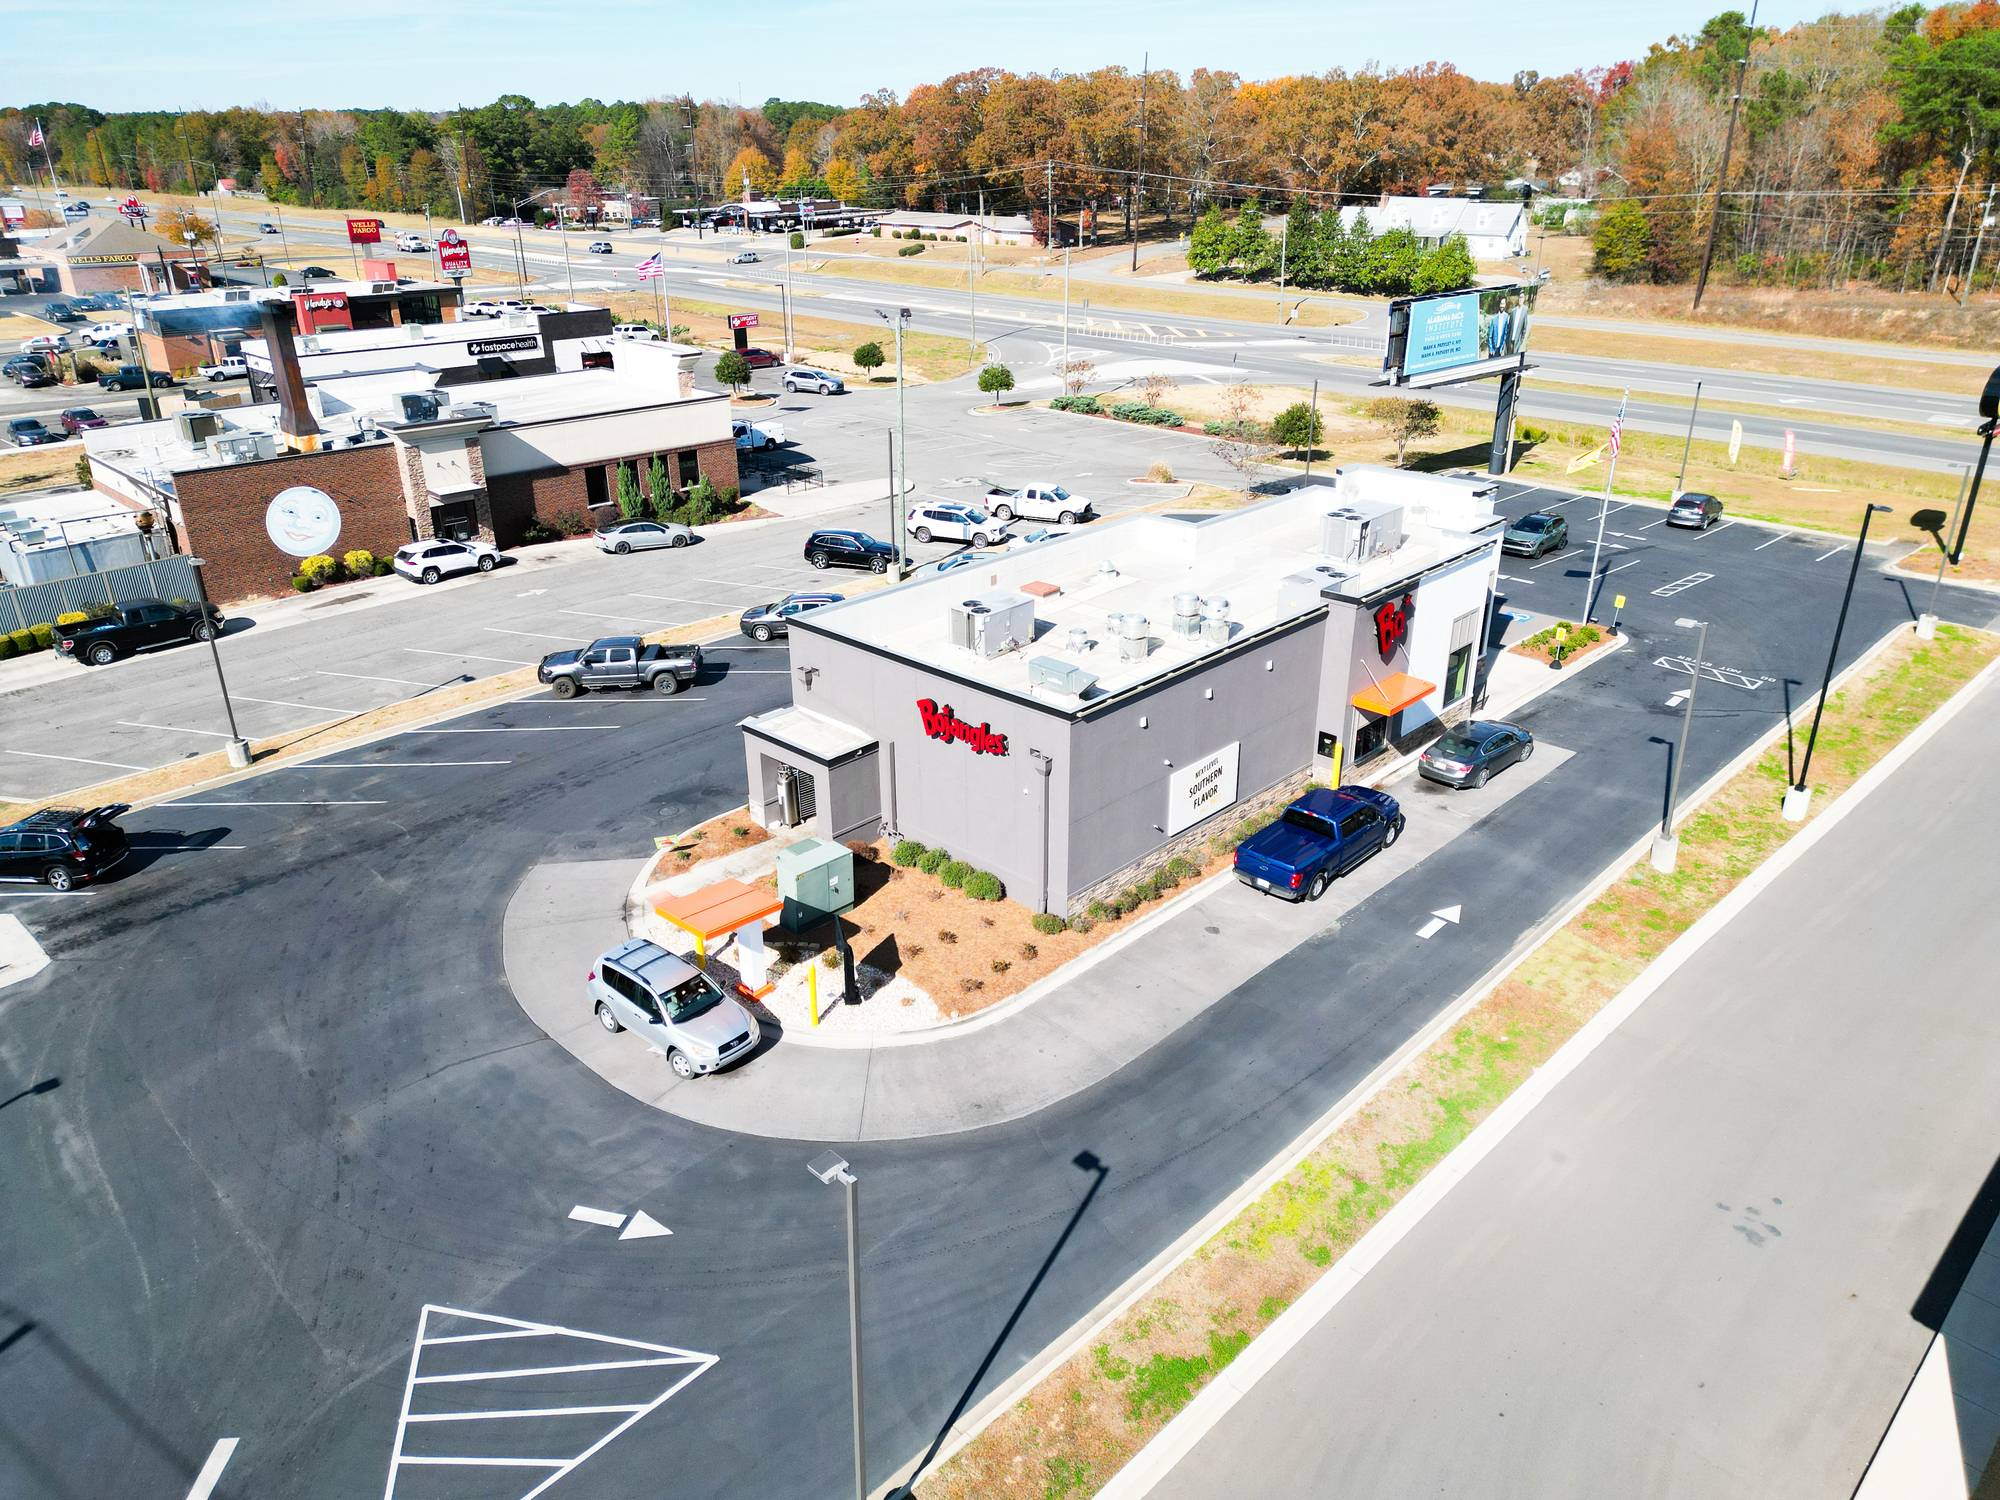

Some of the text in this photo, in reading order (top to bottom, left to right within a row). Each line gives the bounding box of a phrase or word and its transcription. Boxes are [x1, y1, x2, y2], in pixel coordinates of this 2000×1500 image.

[68, 254, 134, 264] WELLS FARGO
[1426, 313, 1450, 323] ALABAMA
[1425, 319, 1463, 333] INSTITUTE
[1718, 666, 1742, 674] NOT
[1760, 675, 1777, 683] DO
[916, 698, 1007, 755] Bojangles
[1195, 757, 1219, 779] NEXT LEVEL
[1189, 766, 1223, 798] SOUTHERN
[1193, 784, 1218, 809] FLAVOR
